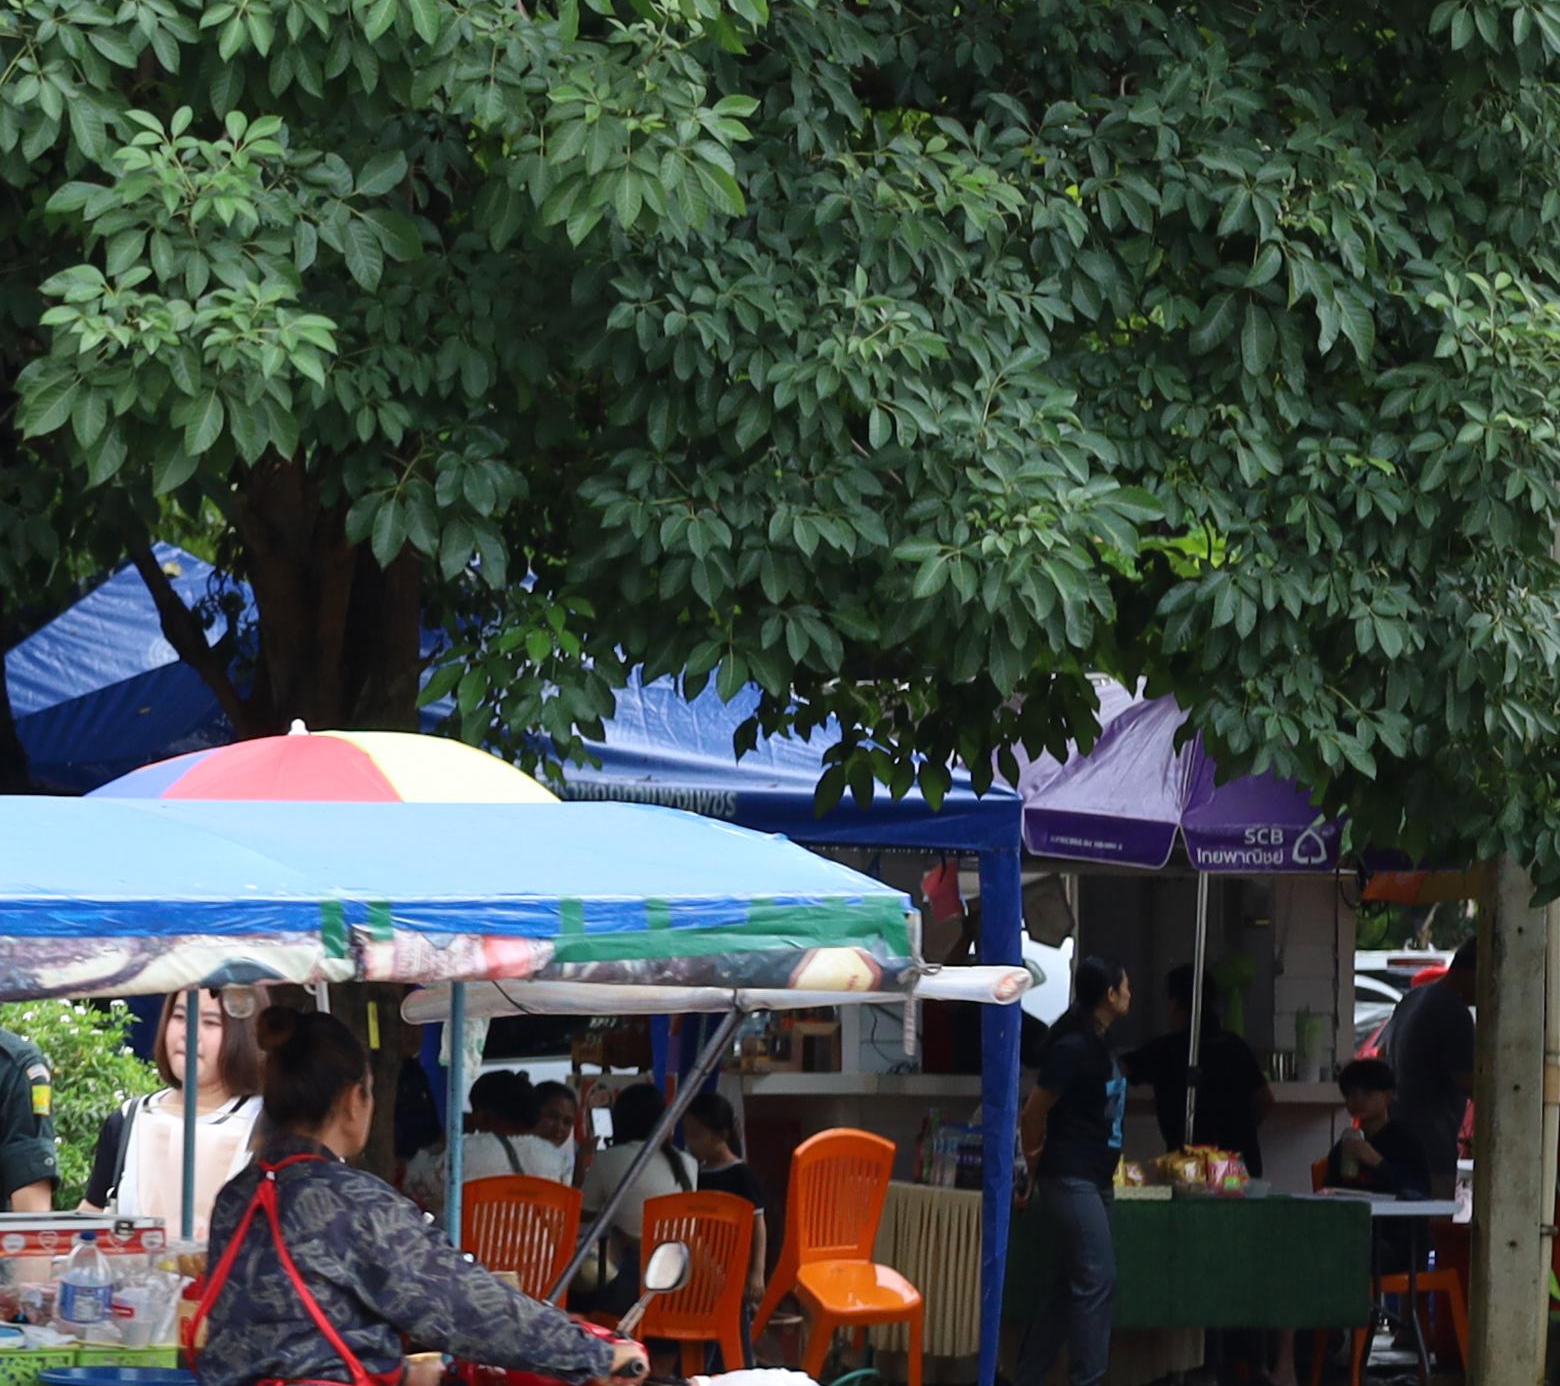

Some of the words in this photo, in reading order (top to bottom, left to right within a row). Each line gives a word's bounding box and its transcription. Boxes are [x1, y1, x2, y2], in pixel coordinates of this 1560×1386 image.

[1244, 827, 1284, 844] SCB
[1196, 844, 1284, 865] ไทยพาณิชย์
